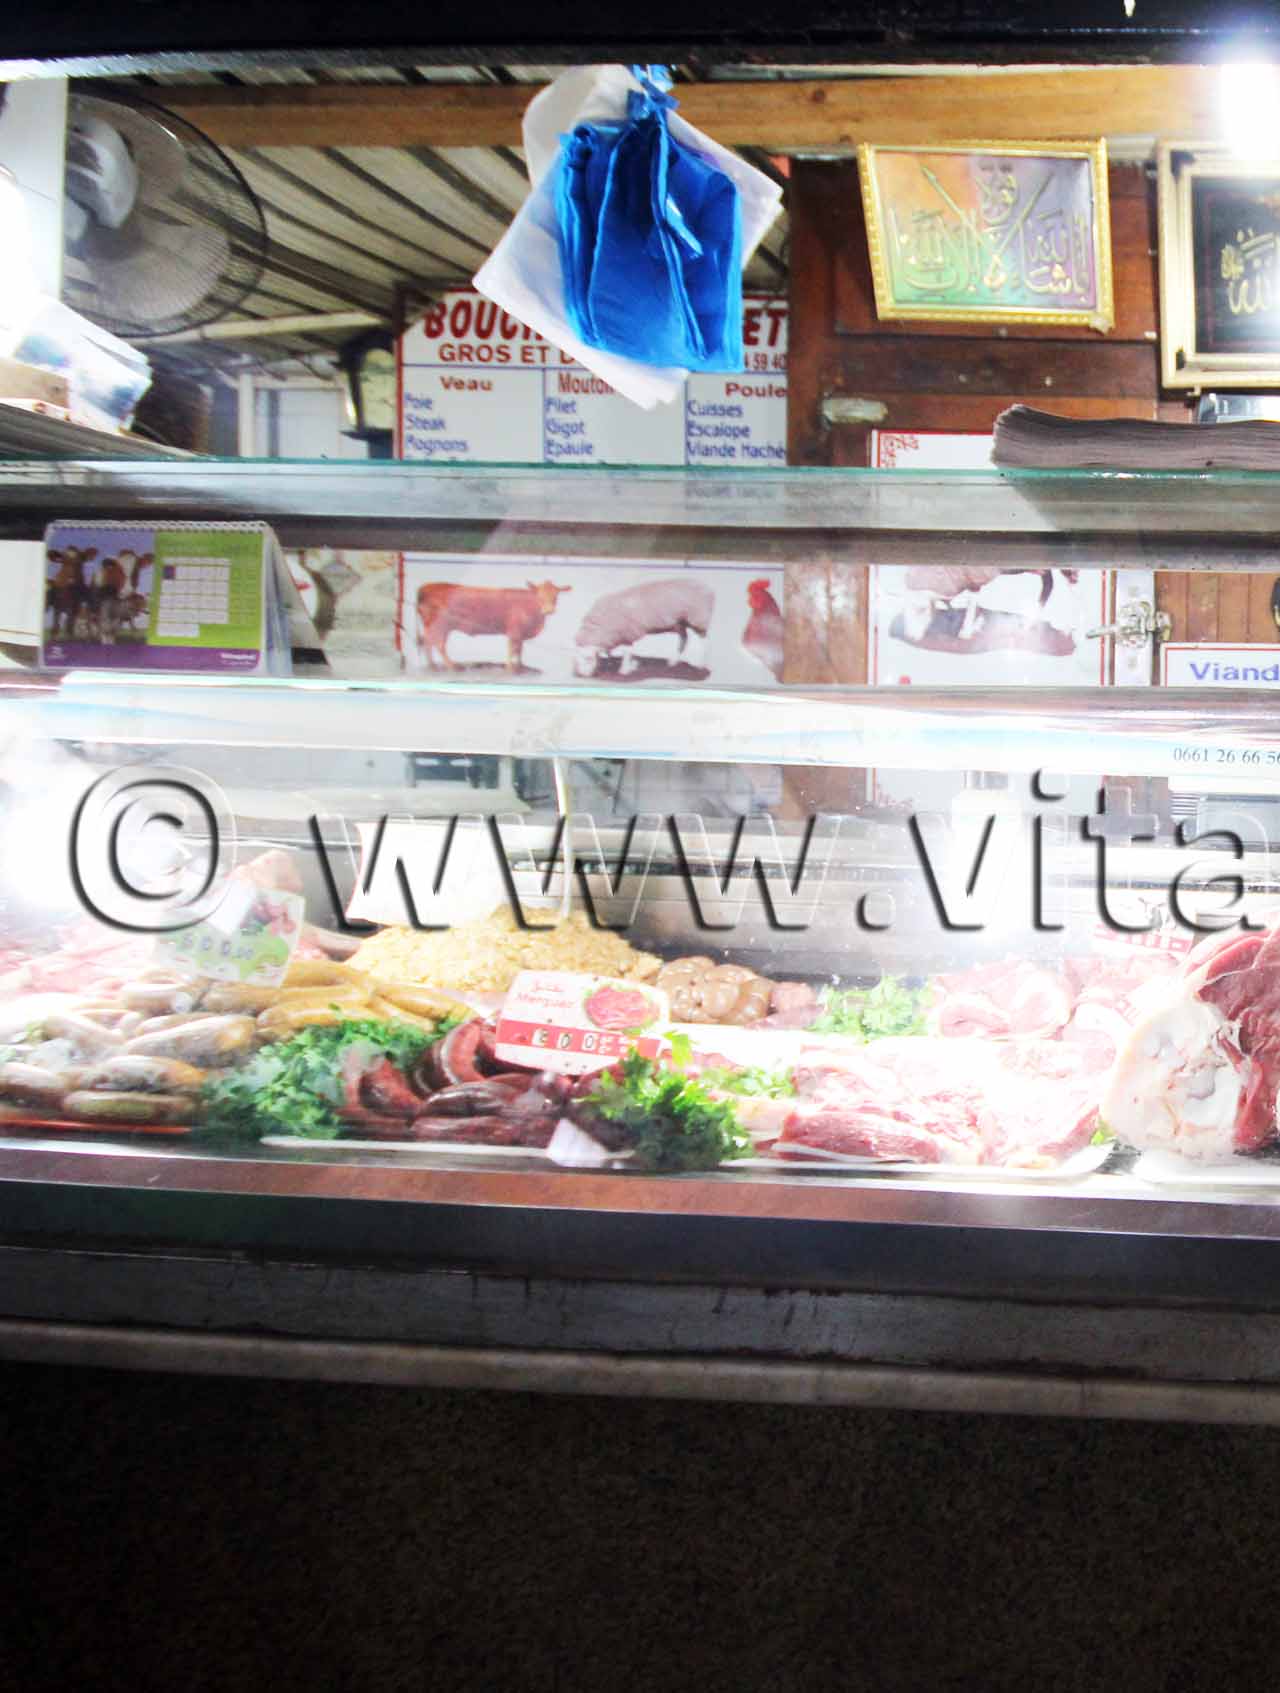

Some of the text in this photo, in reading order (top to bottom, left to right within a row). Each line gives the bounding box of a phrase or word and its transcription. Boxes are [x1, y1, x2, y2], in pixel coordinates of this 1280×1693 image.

[438, 343, 513, 364] GROS
[521, 345, 550, 364] ET
[440, 376, 493, 392] Veau
[687, 400, 744, 419] Cuisses
[405, 415, 446, 431] Steak
[687, 420, 751, 440] Escalope
[1172, 745, 1210, 764] 0661
[1215, 747, 1237, 765] 26
[1240, 748, 1262, 766] 66
